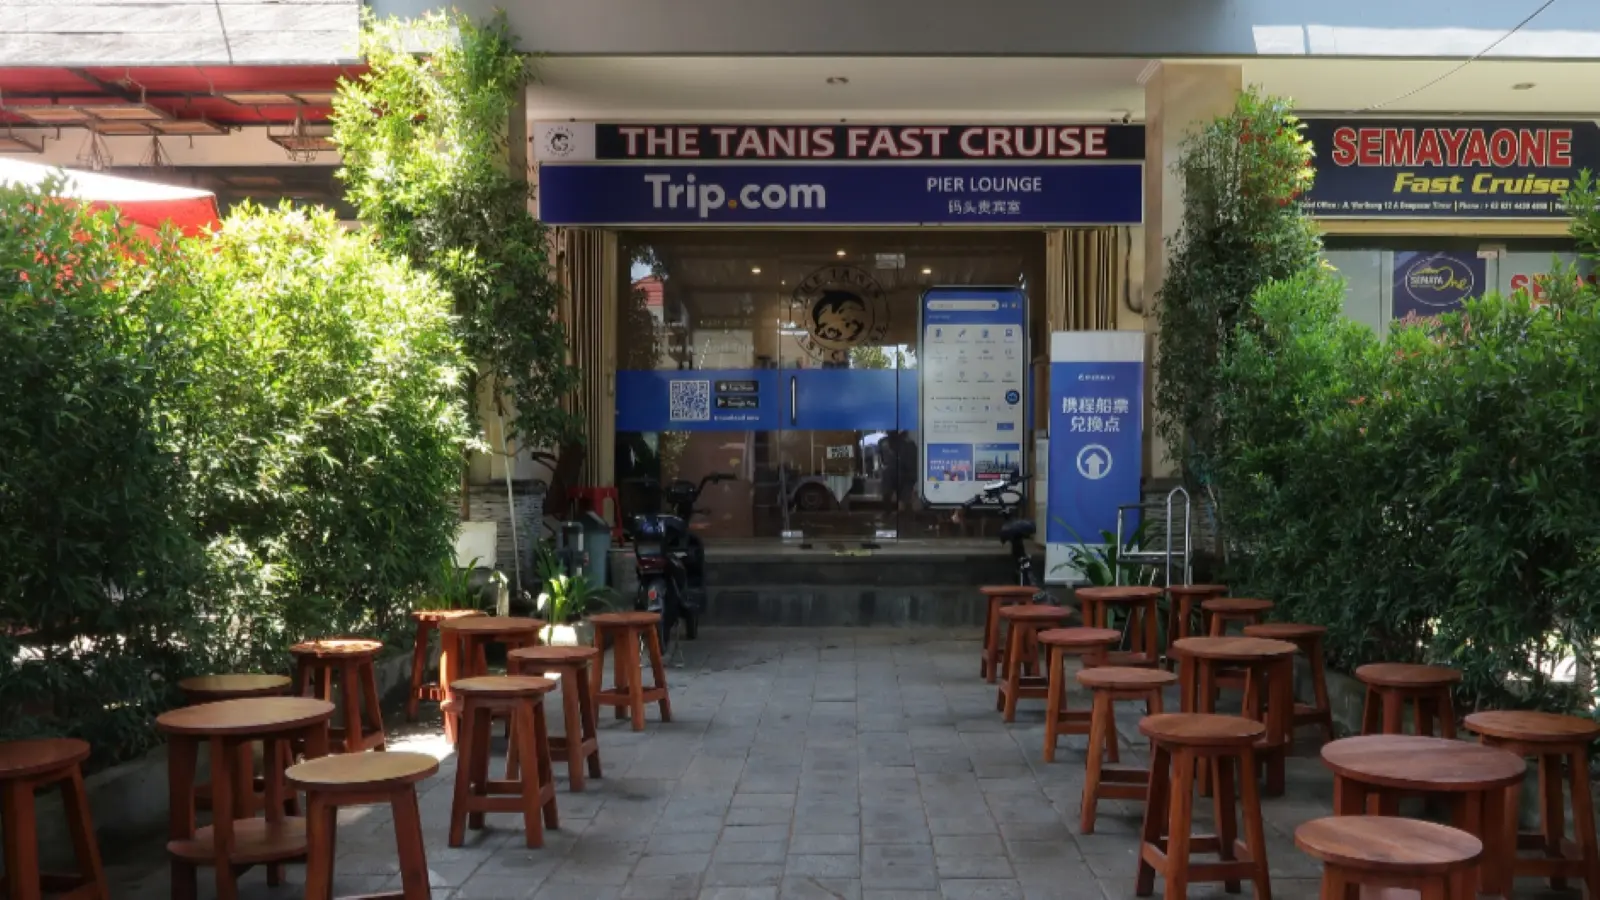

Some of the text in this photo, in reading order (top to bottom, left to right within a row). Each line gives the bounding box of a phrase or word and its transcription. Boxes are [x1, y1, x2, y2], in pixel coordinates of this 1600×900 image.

[618, 126, 1108, 157] THE TANIS FAST CRUISE
[1332, 126, 1573, 168] SEMAYAONE
[926, 177, 1042, 193] PIER LOUNGE
[1393, 172, 1570, 194] Fast Cruise
[644, 173, 826, 218] Trip.com
[948, 200, 1021, 215] 码头贵宾室
[1062, 396, 1129, 414] 携程船票
[1070, 416, 1121, 433] 兑换点
